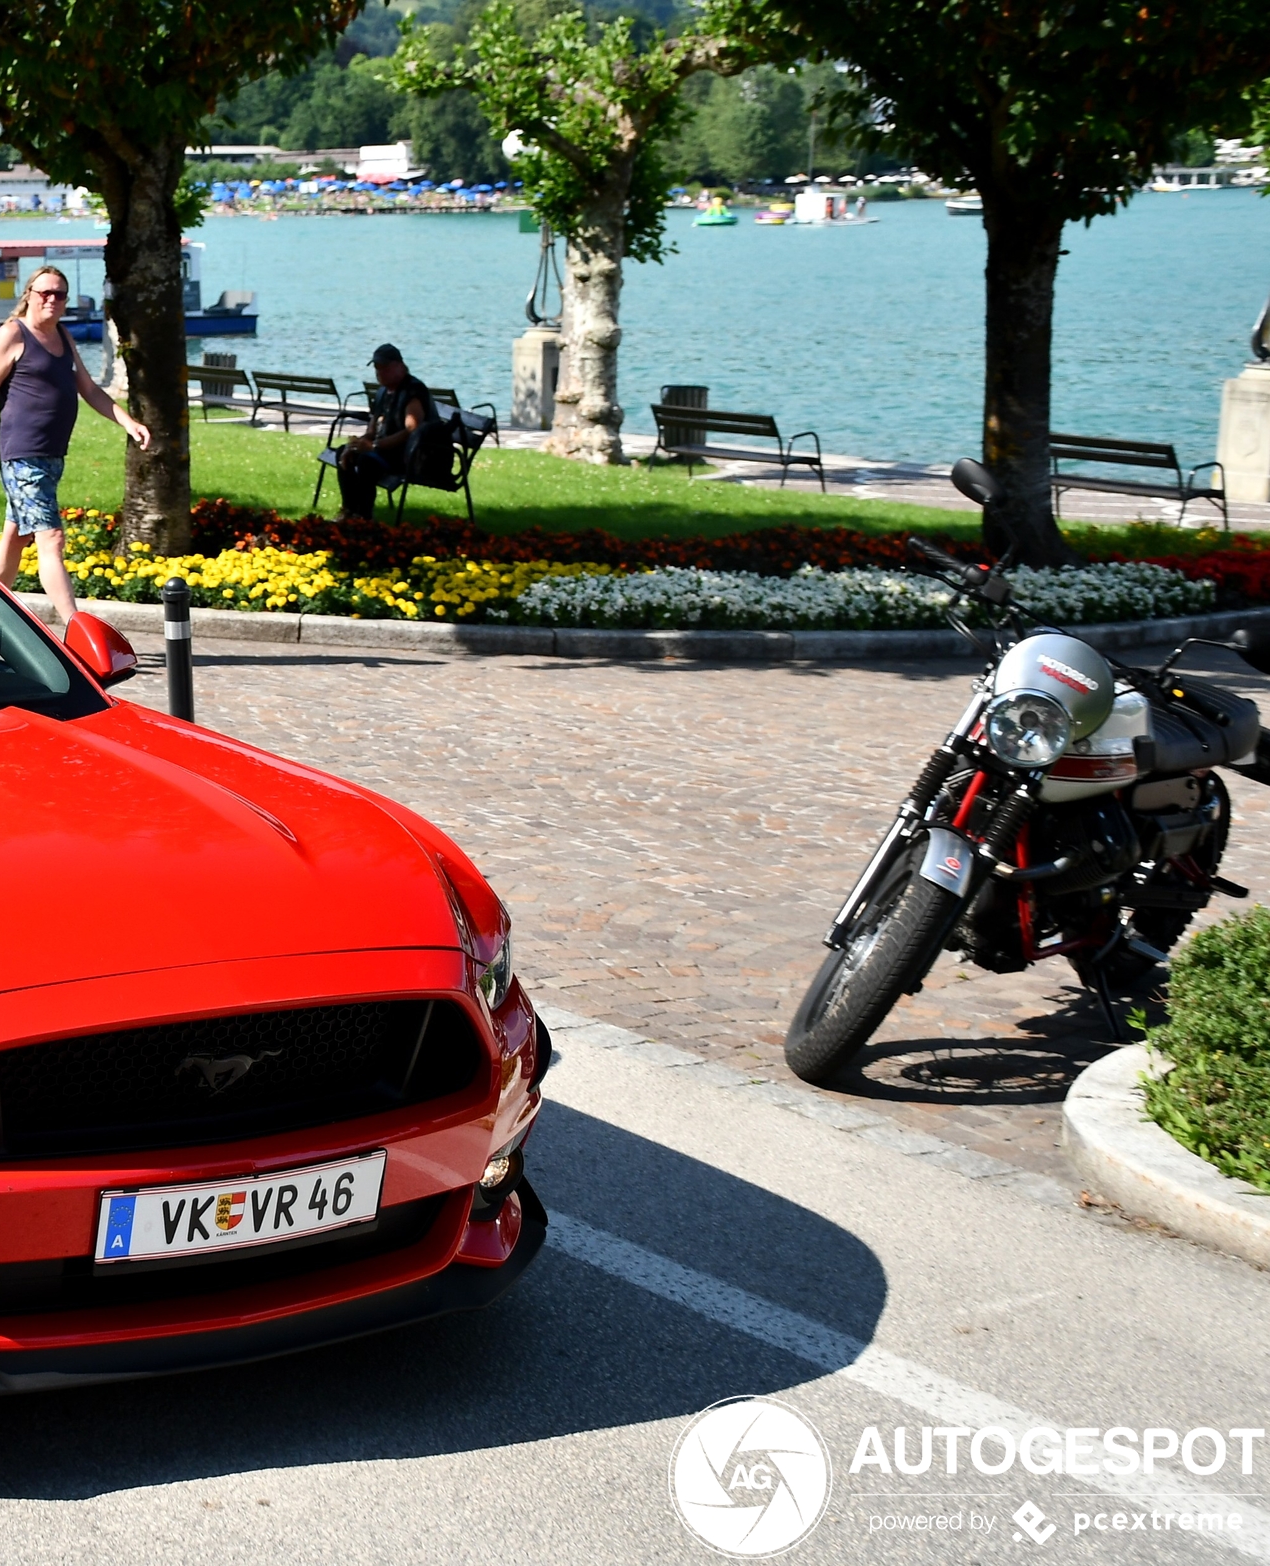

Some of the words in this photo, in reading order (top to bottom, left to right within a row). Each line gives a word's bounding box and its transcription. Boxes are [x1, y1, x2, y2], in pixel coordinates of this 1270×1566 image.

[1036, 653, 1099, 691] MOTORRAD
[162, 1195, 216, 1245] VK
[251, 1184, 299, 1233] VR
[308, 1171, 356, 1221] 46
[110, 1233, 125, 1249] A
